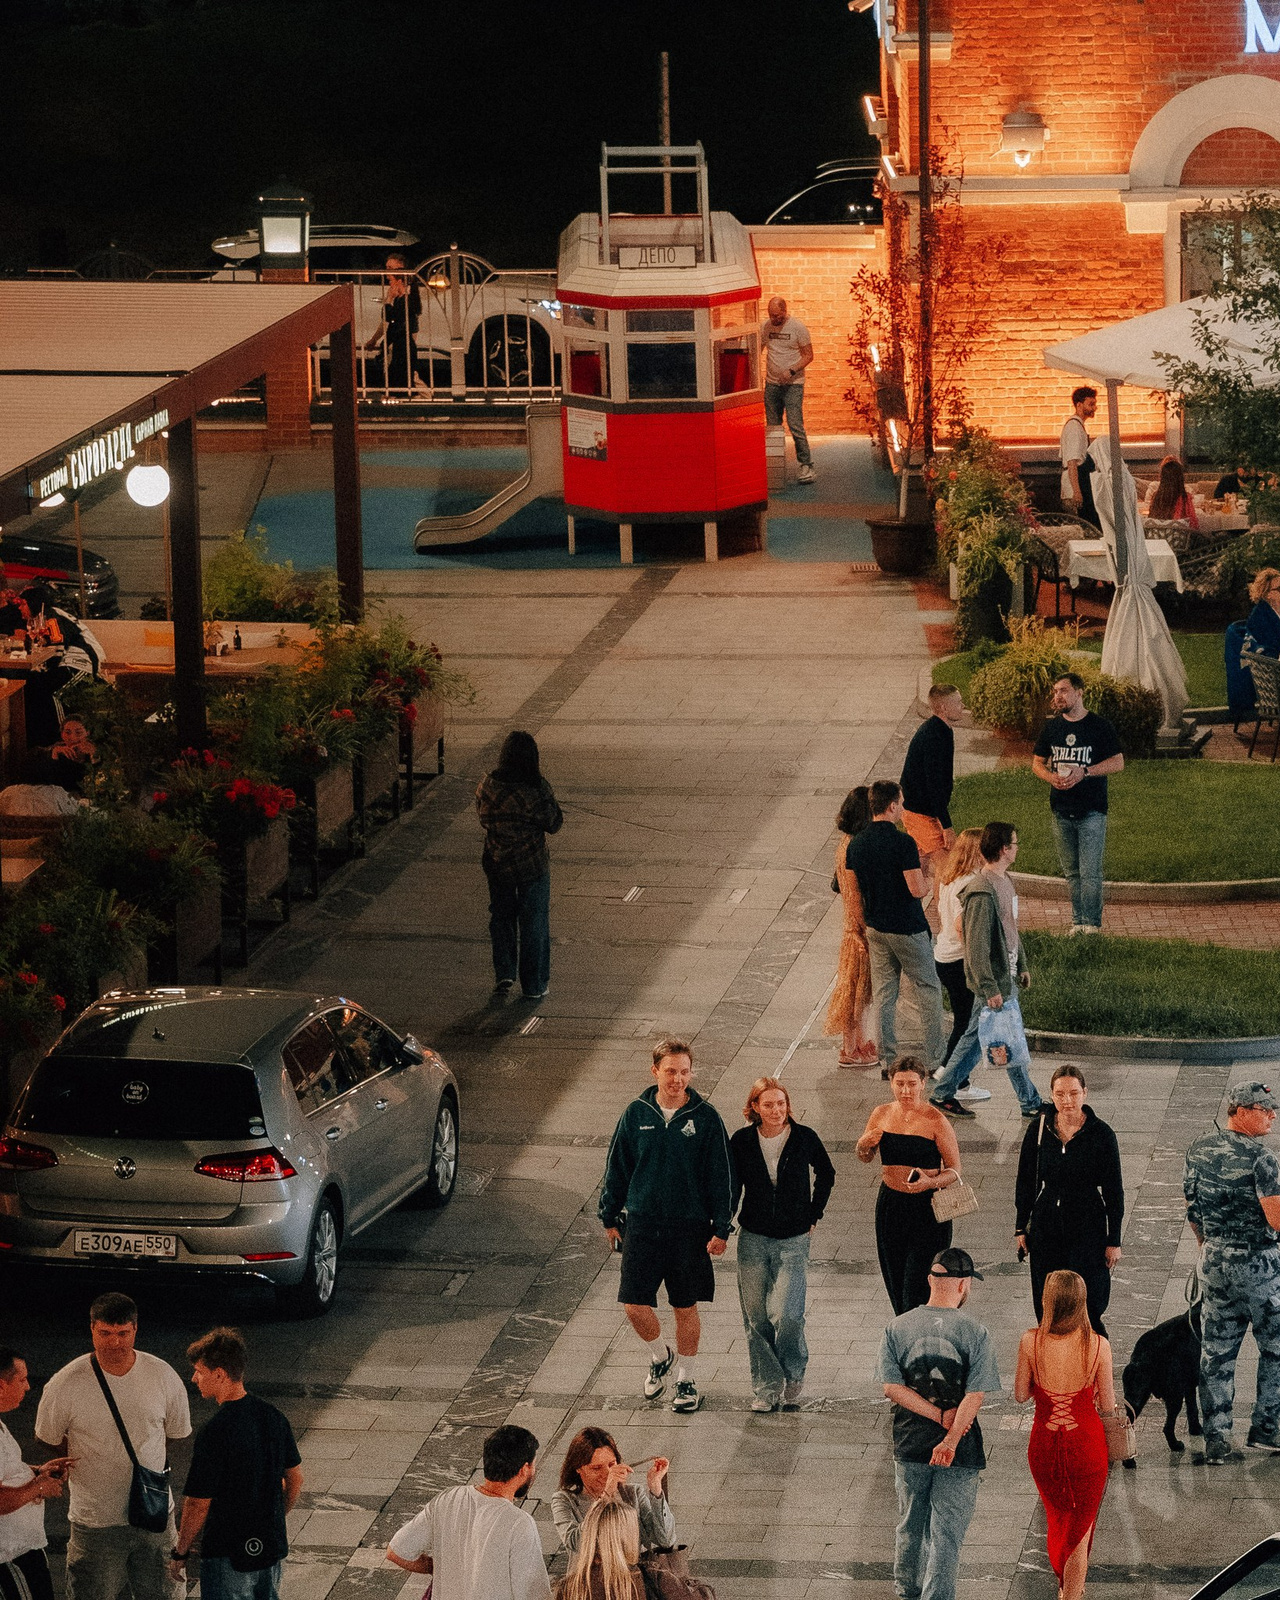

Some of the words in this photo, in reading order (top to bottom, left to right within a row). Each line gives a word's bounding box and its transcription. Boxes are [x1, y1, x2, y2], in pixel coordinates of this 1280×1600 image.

[639, 247, 676, 267] ДЕПО
[40, 465, 69, 499] РЕСТОРАН
[70, 422, 132, 490] СЫРОВАРНЯ
[1051, 745, 1093, 764] ATHLETIC
[146, 1236, 172, 1251] 550
